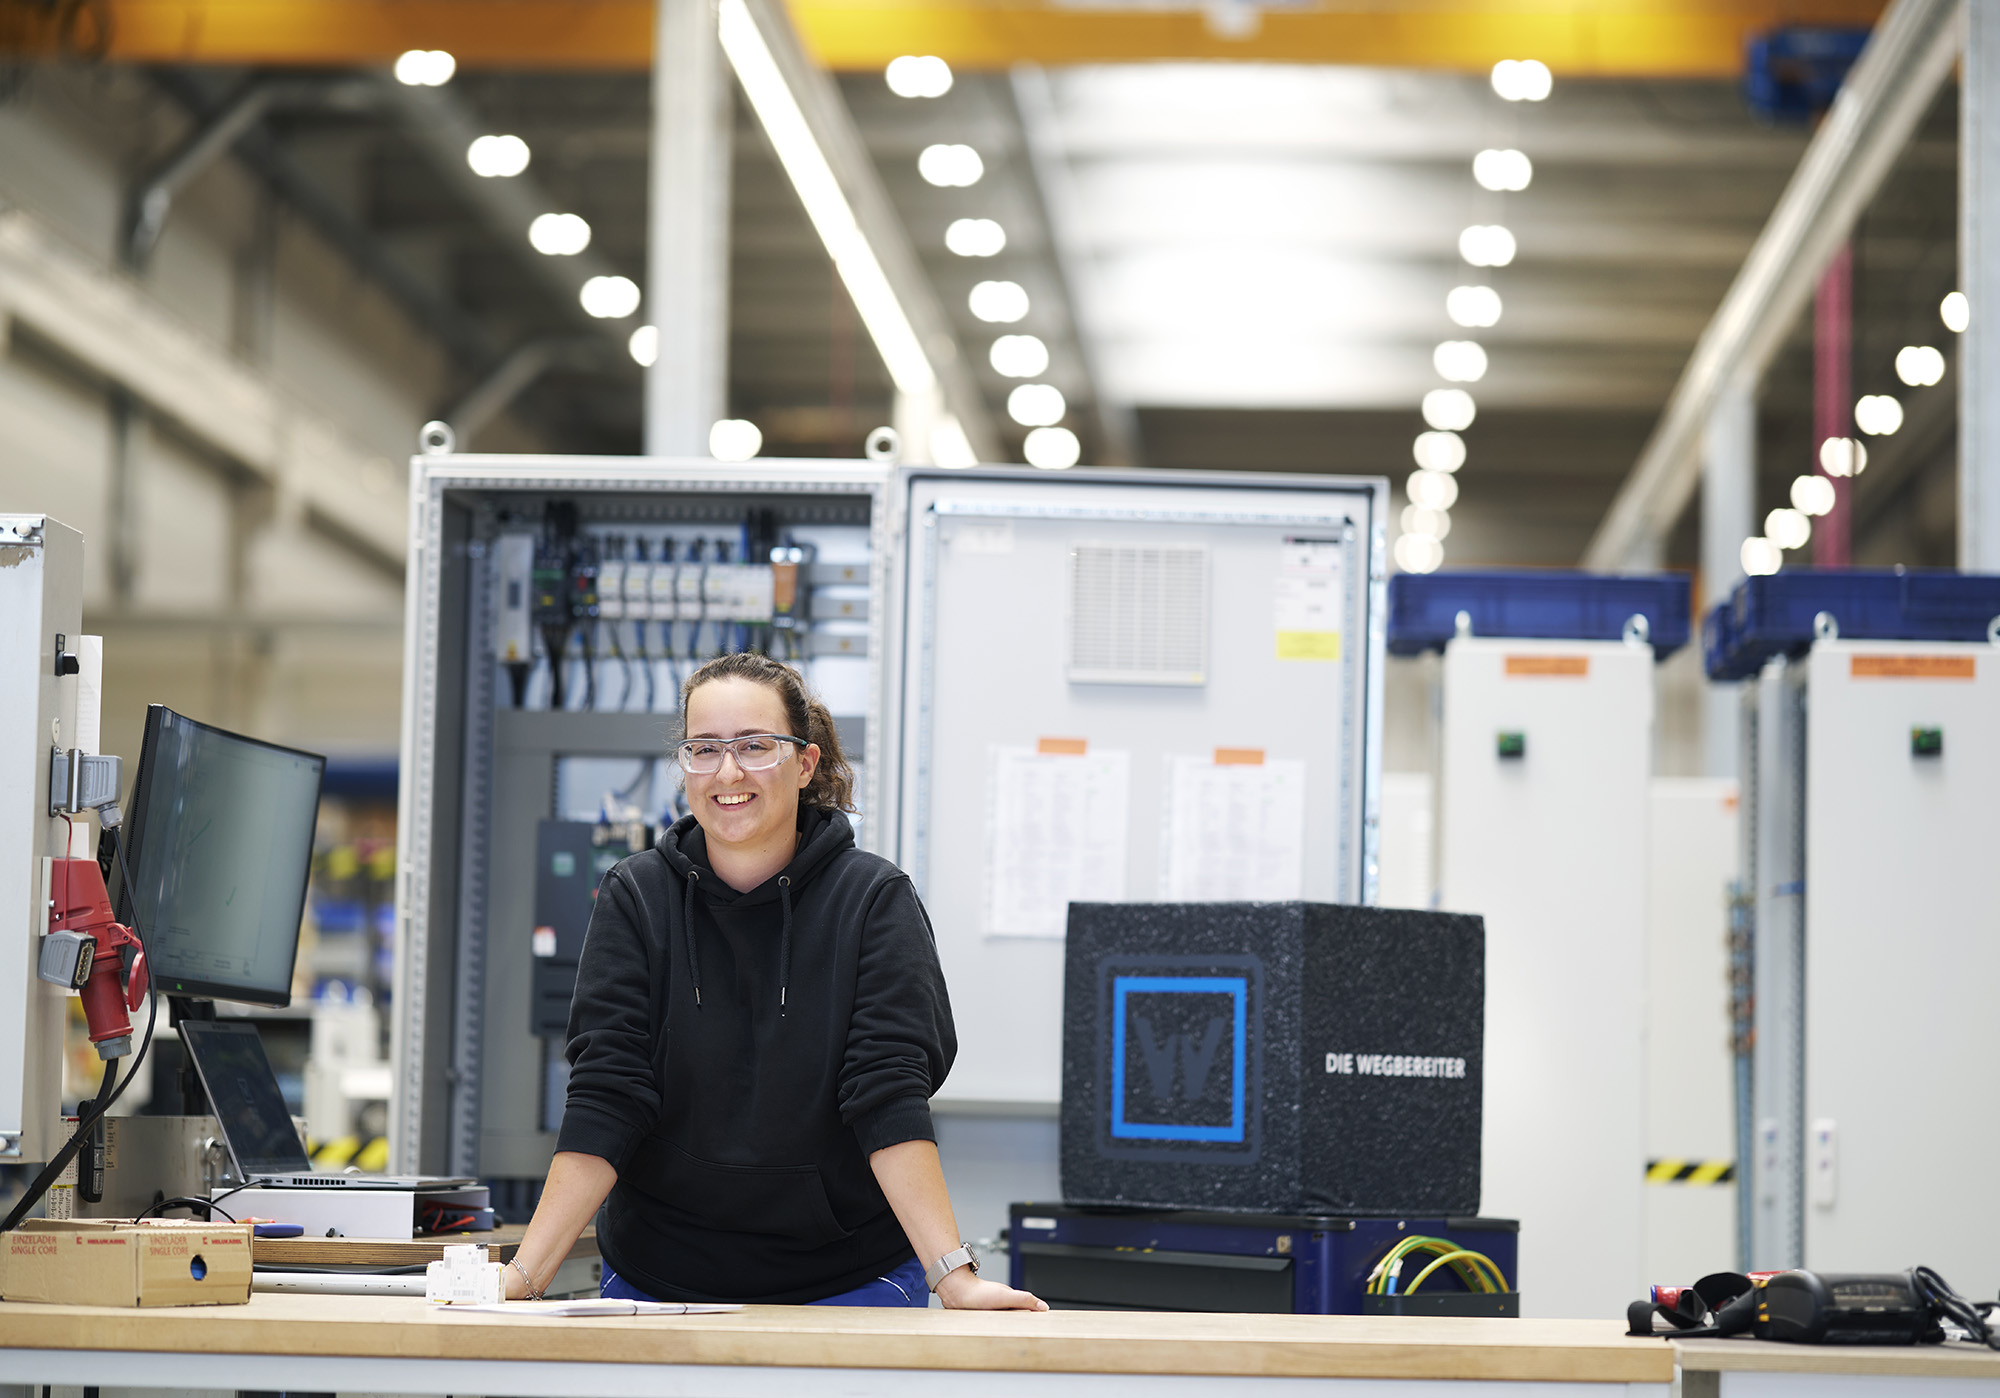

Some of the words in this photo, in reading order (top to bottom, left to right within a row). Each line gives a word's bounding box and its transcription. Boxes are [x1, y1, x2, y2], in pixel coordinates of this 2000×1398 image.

[1325, 1053, 1353, 1075] DIE
[1356, 1054, 1466, 1079] WEGBEREITER
[12, 1235, 57, 1245] EINZELADER
[10, 1245, 36, 1255] SINGLE
[38, 1245, 57, 1255] CORE
[150, 1246, 171, 1256] SINGLE
[172, 1246, 189, 1256] CORE
